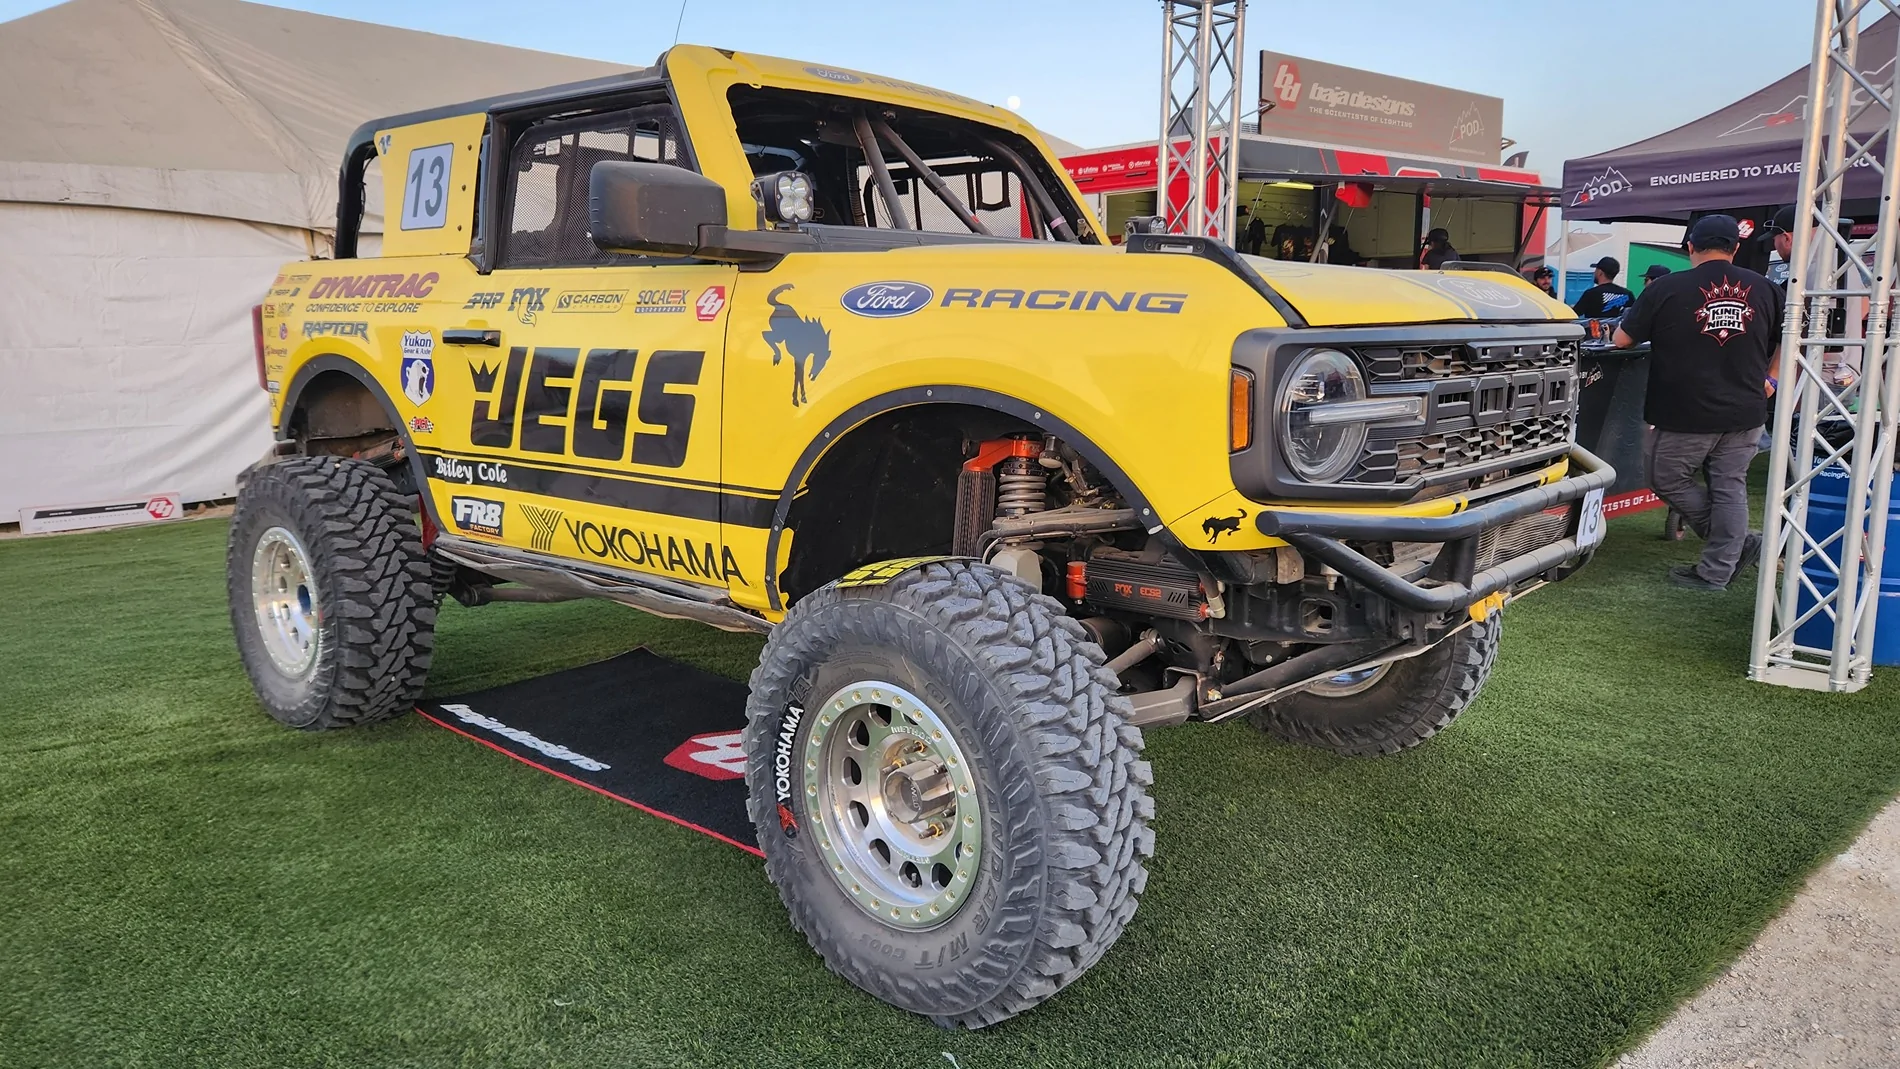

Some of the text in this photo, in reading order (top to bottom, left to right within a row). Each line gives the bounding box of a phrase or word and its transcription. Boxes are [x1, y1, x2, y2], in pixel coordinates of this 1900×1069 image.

[1309, 82, 1350, 107] baja
[1324, 109, 1368, 121] SCIENTISTS
[1380, 117, 1413, 128] LIGHTING
[1460, 120, 1480, 139] POD
[1650, 167, 1738, 187] ENGINEERED
[1742, 166, 1762, 178] TO
[1764, 161, 1801, 176] TAKE
[411, 156, 445, 218] 13
[1588, 179, 1623, 201] POD
[308, 272, 440, 300] DYNATRAC
[305, 303, 361, 313] CONFIDENCE
[362, 302, 376, 313] TO
[374, 302, 421, 313] EXPLORE
[462, 292, 505, 309] PRP
[507, 287, 550, 314] FOX
[573, 294, 624, 304] CARBON
[857, 283, 1188, 314] Ford RACING
[1707, 320, 1742, 328] NIGHT
[1712, 308, 1740, 320] KING
[302, 321, 370, 344] RAPTOR
[404, 335, 432, 347] Yukon
[469, 346, 705, 468] JEGS
[413, 418, 428, 429] PCI
[478, 463, 508, 483] Cole
[1820, 471, 1850, 480] RacingFu
[453, 498, 501, 527] FR8
[1601, 499, 1631, 513] TISTS
[1633, 496, 1644, 505] OF
[1581, 498, 1600, 536] 13
[470, 523, 500, 534] FACTORY
[564, 518, 750, 587] YOKOHAMA
[1114, 583, 1133, 598] FOX
[775, 705, 805, 803] YOKOHAMA
[914, 931, 971, 970] M/T
